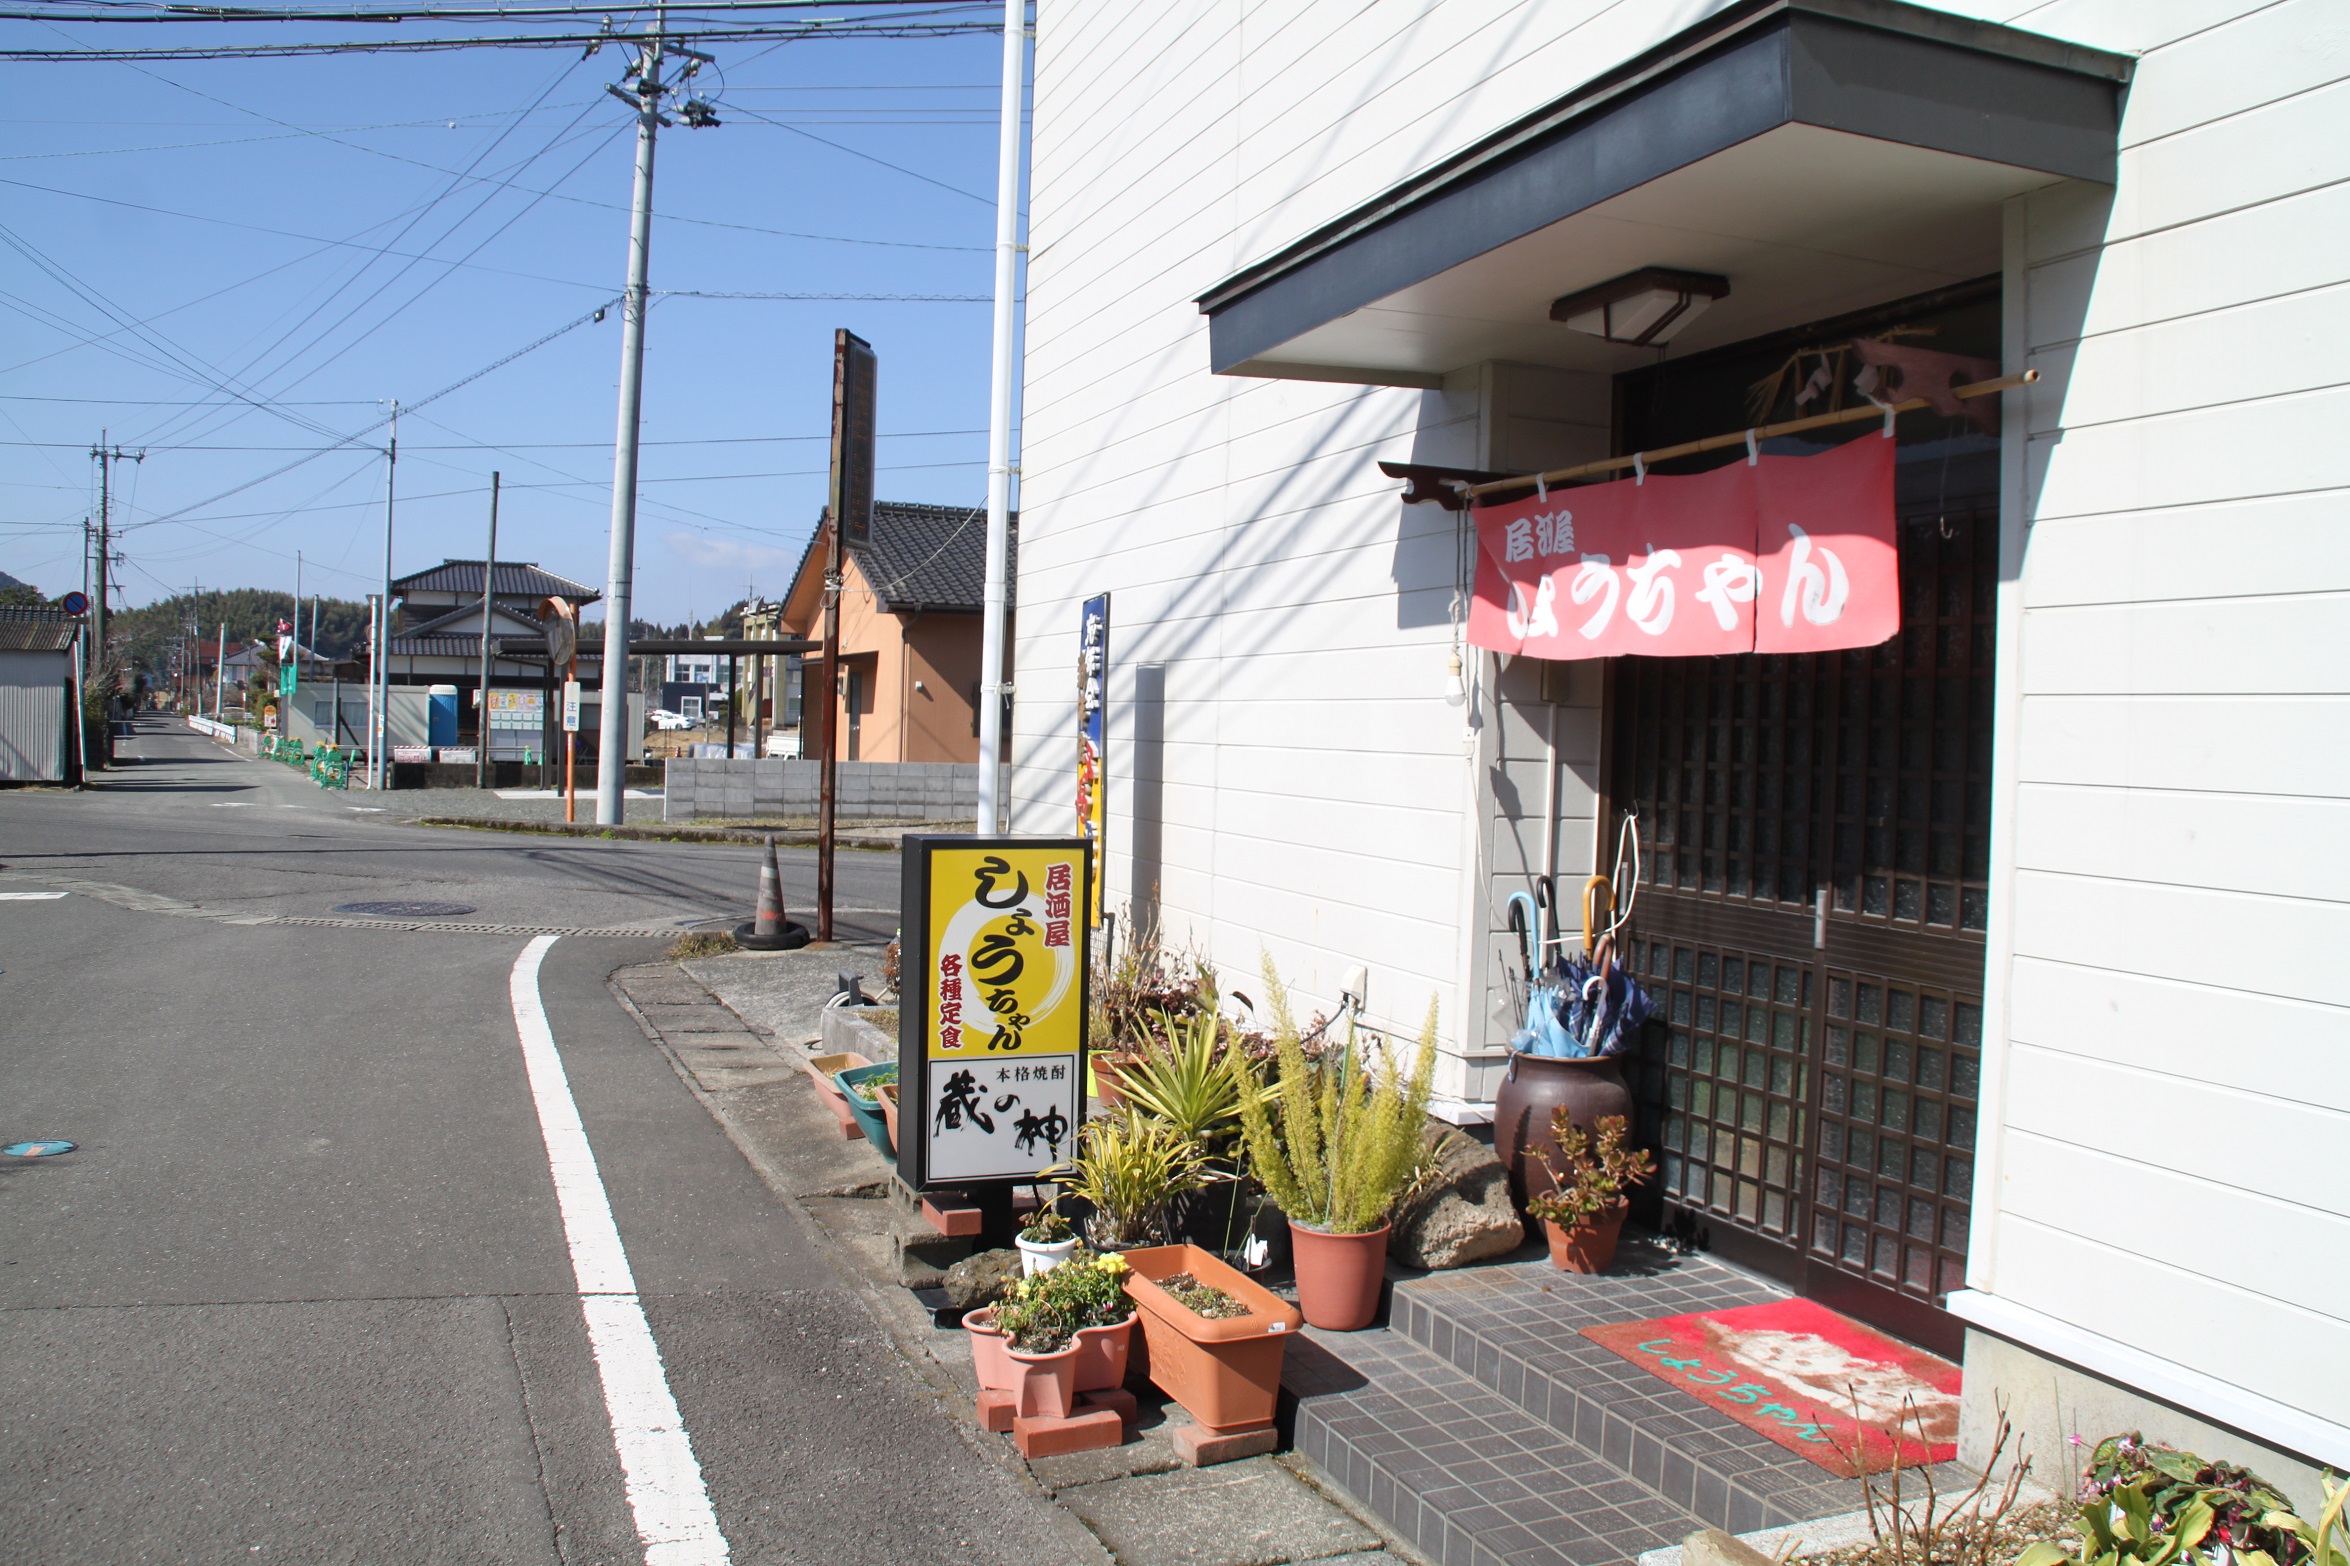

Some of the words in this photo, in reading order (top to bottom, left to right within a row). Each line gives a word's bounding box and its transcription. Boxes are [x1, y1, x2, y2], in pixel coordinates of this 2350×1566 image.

[1505, 510, 1575, 562] 居酒屋
[565, 701, 577, 727] 注意
[1045, 863, 1072, 947] 居酒屋
[971, 856, 1034, 1051] しょうちゃん
[939, 953, 963, 1049] 各種定食
[933, 1068, 1068, 1163] 蔵の神
[995, 1065, 1066, 1082] 本格焼酎
